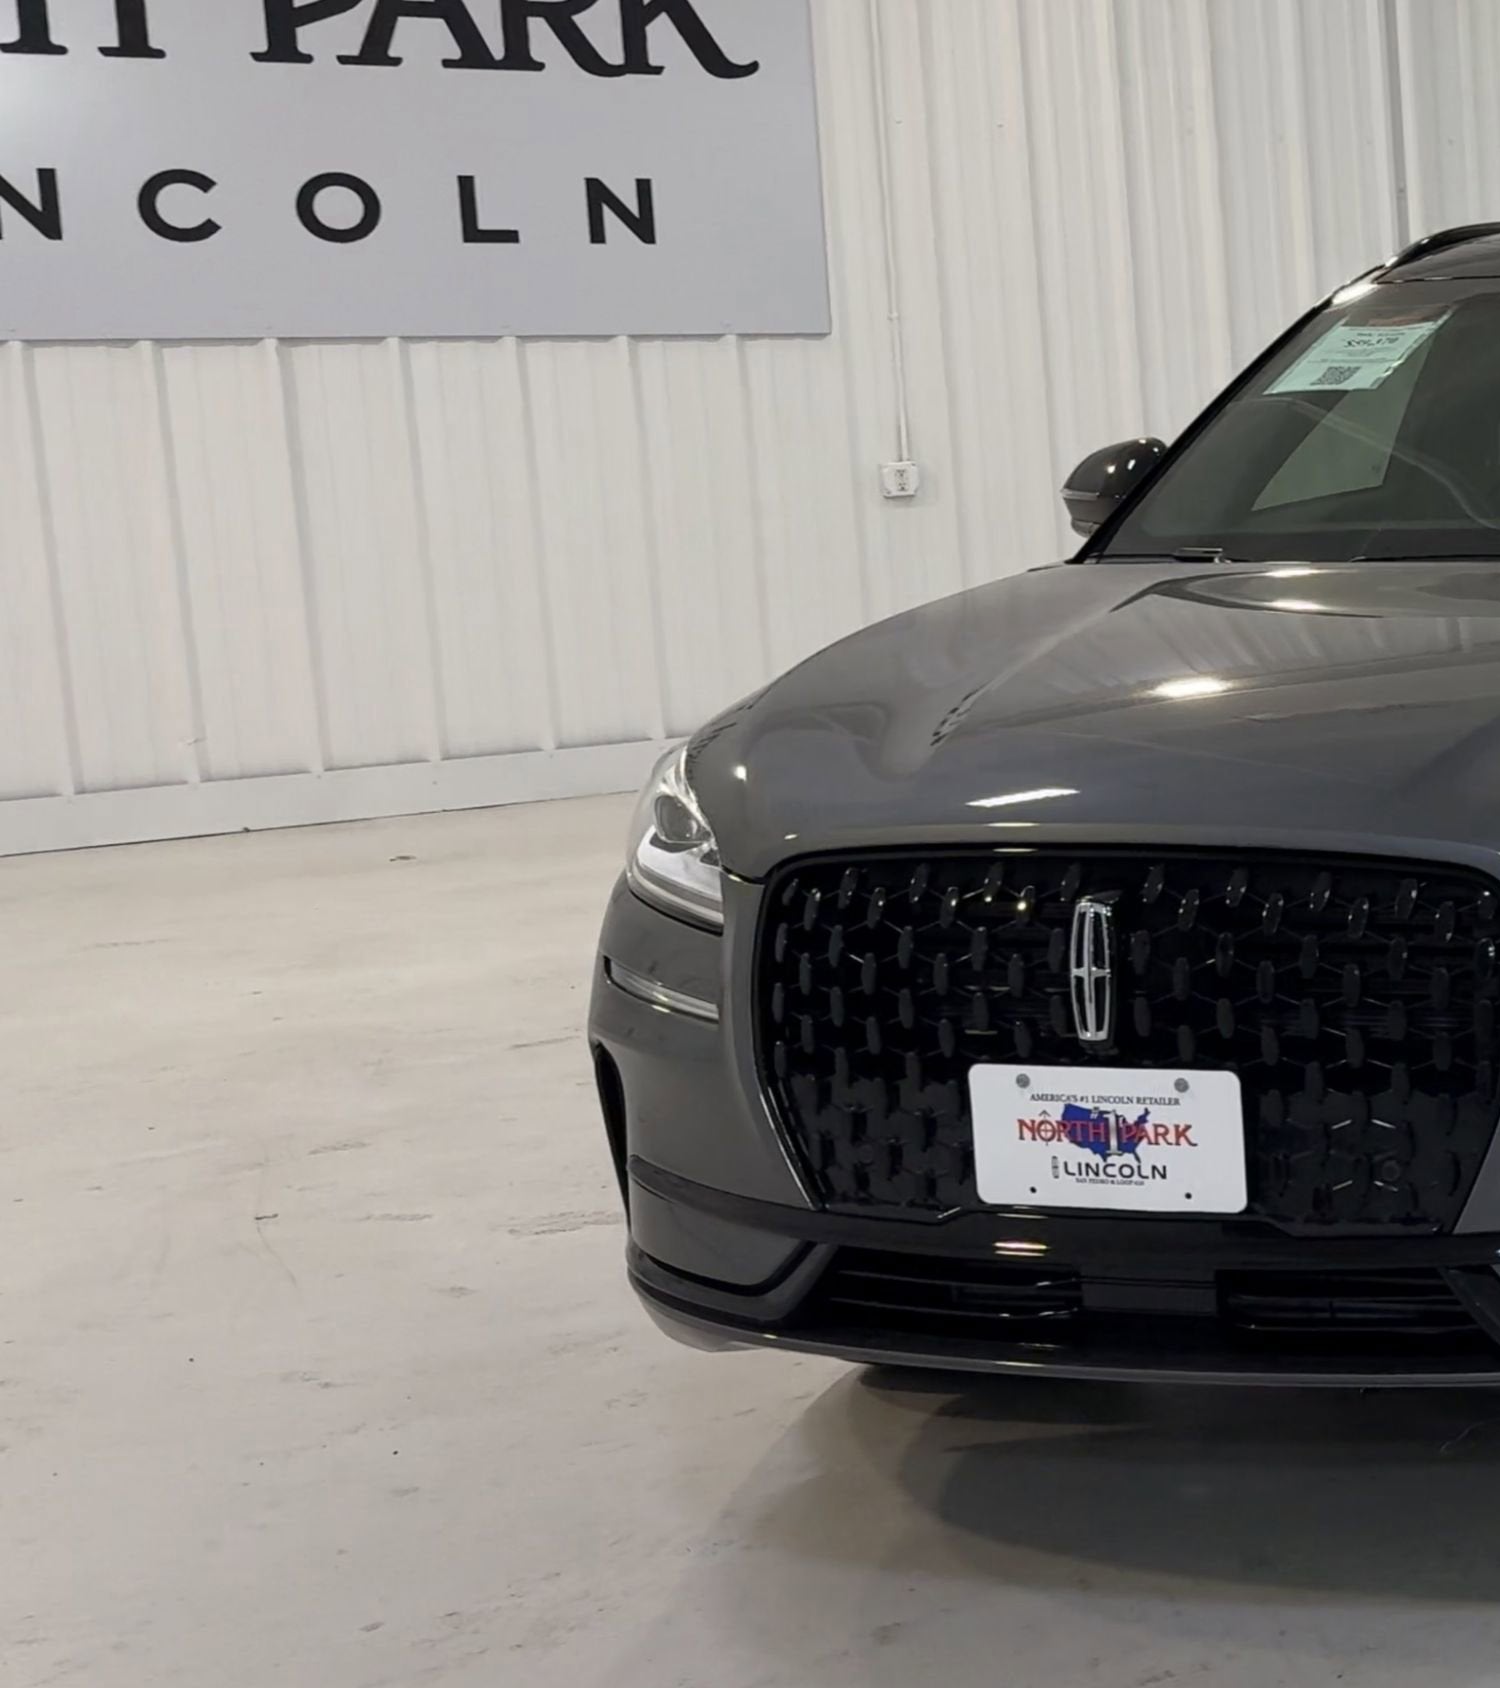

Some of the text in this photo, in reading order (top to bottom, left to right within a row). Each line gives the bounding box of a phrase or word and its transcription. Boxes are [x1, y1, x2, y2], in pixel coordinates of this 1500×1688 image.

[1092, 1095, 1134, 1105] LINCOLN
[1136, 1096, 1181, 1106] RETAILER
[1016, 1117, 1199, 1147] NORTH PARK
[1063, 1160, 1168, 1180] LINCOLN
